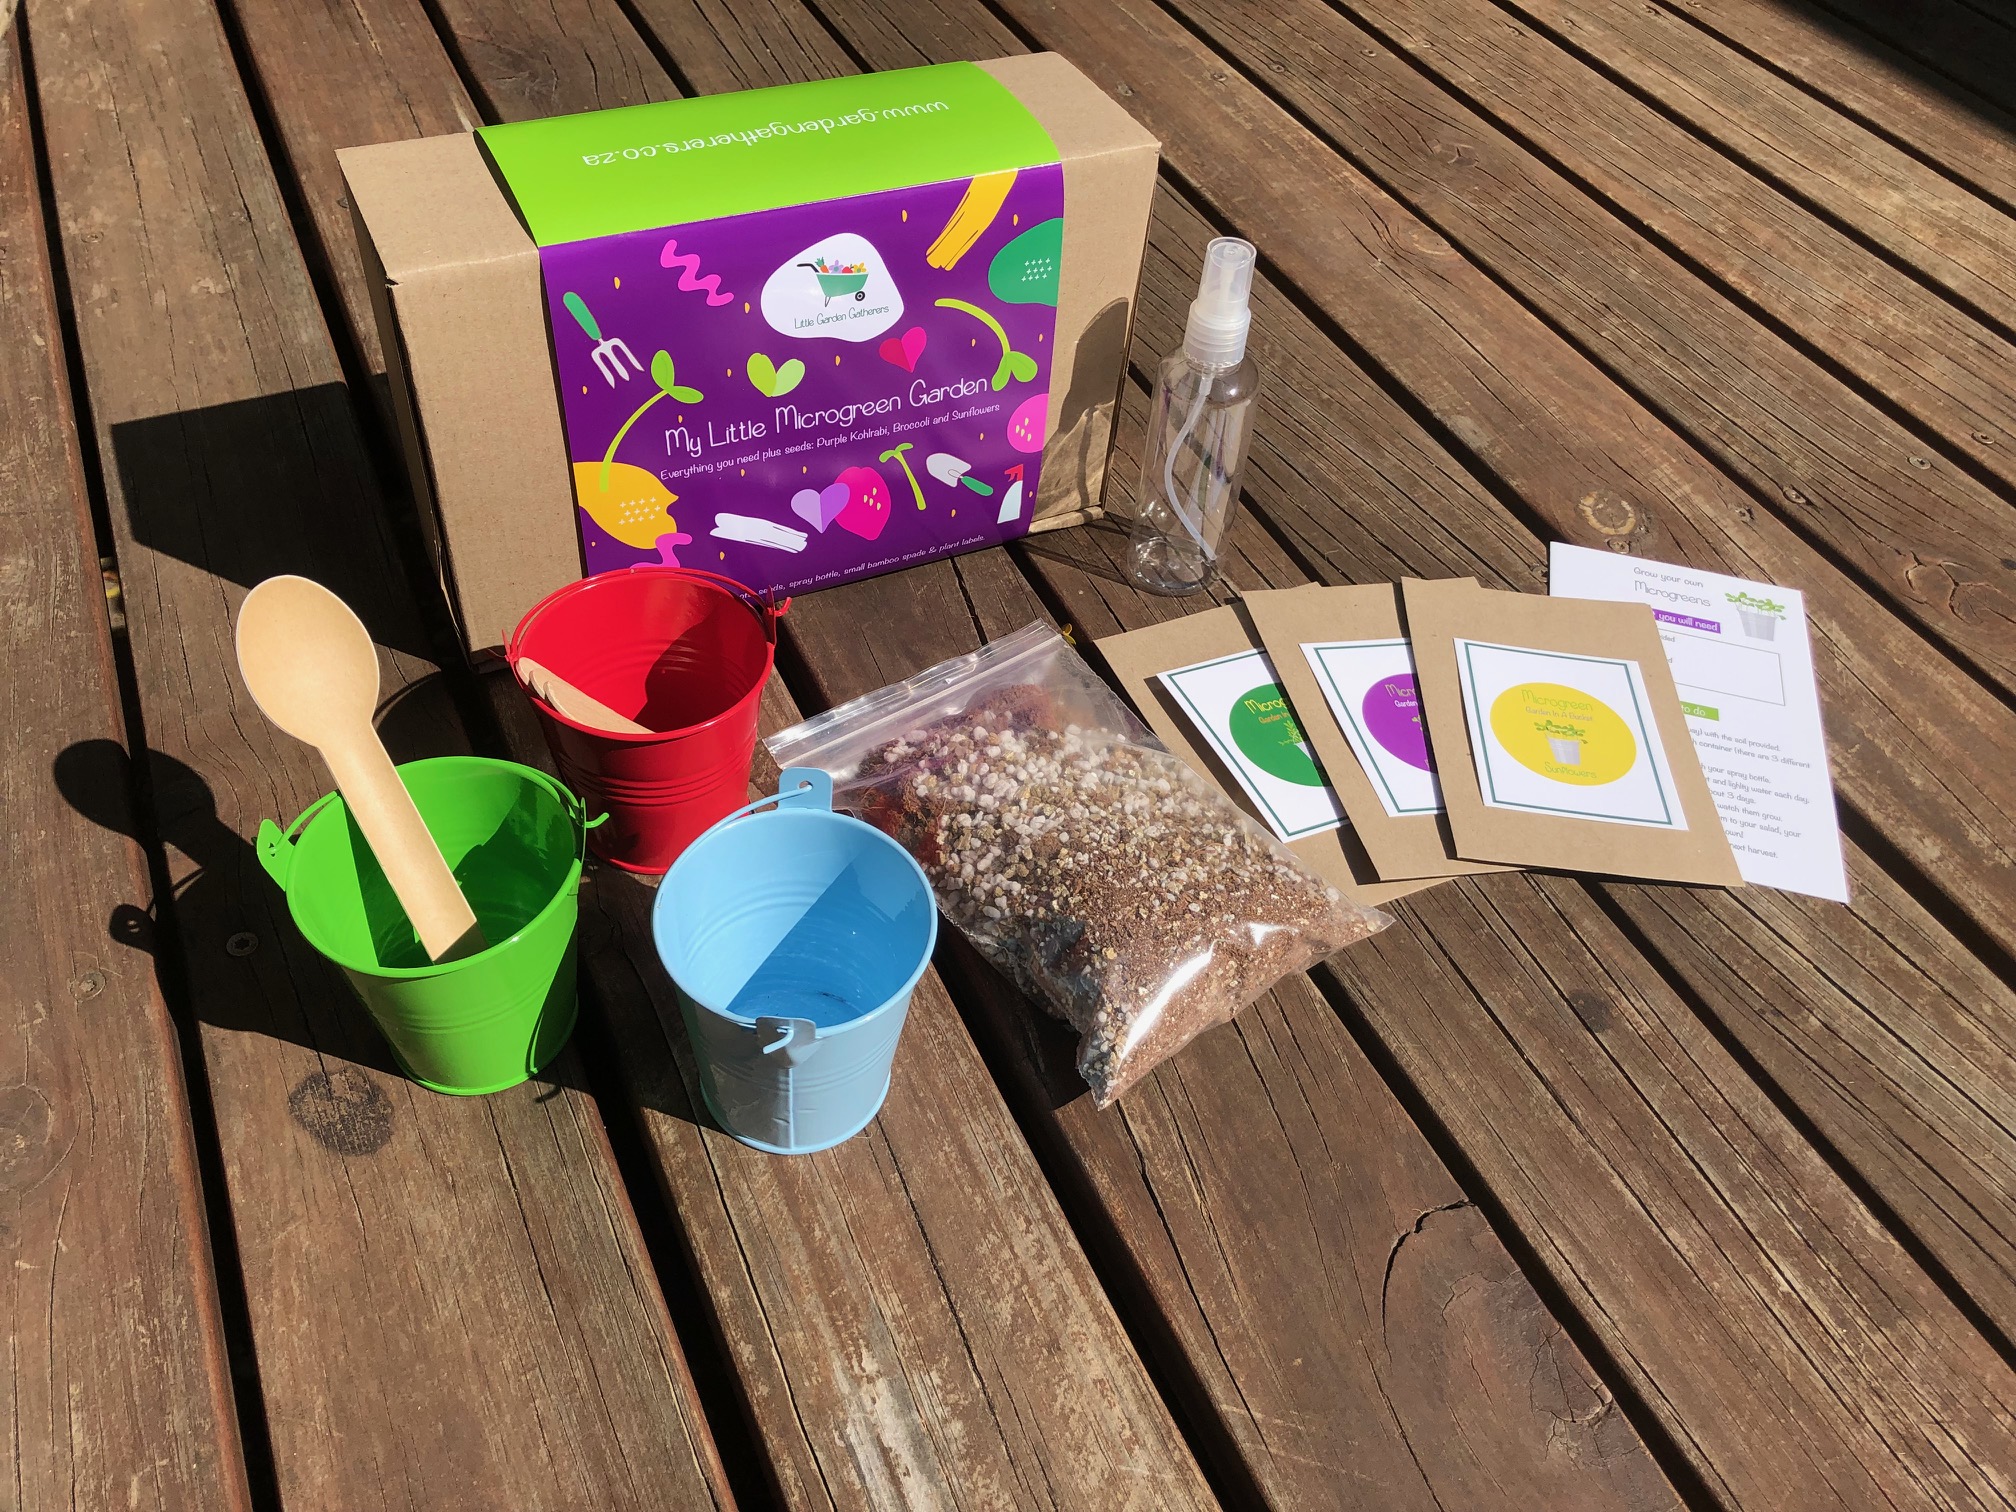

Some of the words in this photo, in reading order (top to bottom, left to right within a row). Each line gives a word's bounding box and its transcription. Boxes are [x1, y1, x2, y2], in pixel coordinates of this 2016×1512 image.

[581, 100, 950, 167] www.gardengatherers.co.za
[794, 318, 815, 330] Little
[816, 312, 847, 326] Garden
[848, 305, 890, 320] Gatherers
[665, 426, 702, 458] My
[709, 420, 767, 448] Little
[775, 395, 902, 434] Microgreen
[909, 378, 988, 408] Garden
[660, 463, 715, 481] Everything
[716, 458, 735, 472] you
[736, 450, 760, 465] need
[762, 447, 782, 463] plus
[784, 441, 815, 455] seeds:
[816, 433, 848, 451] Purple
[850, 426, 891, 442] Kohlrabi,
[893, 416, 931, 433] Broccoli
[932, 411, 950, 426] and
[951, 403, 1001, 421] Sunflowers
[758, 583, 786, 596] seds,
[789, 577, 813, 590] spray
[815, 570, 842, 583] bottle,
[843, 563, 866, 575] small
[867, 556, 900, 571] bamboo
[901, 549, 927, 563] spade
[928, 546, 938, 554] &
[938, 541, 960, 554] plant
[1633, 566, 1659, 581] Grow
[1660, 574, 1682, 585] your
[1684, 580, 1705, 588] own
[1634, 580, 1711, 608] Microgreens
[1658, 613, 1676, 623] you
[1677, 616, 1693, 627] will
[1695, 620, 1718, 631] need
[1521, 689, 1594, 712] Microgreen
[1693, 706, 1705, 716] do
[1525, 706, 1551, 717] Garden
[1552, 710, 1560, 718] In
[1703, 730, 1719, 740] with
[1721, 733, 1733, 742] the
[1734, 736, 1747, 745] soil
[1748, 739, 1781, 752] provided.
[1698, 740, 1733, 753] container
[1757, 752, 1770, 760] are
[1771, 754, 1779, 762] 3
[1780, 756, 1811, 769] different
[1544, 761, 1597, 779] Sunflowers
[1707, 764, 1725, 775] your
[1726, 768, 1748, 780] spray
[1712, 777, 1727, 787] and
[1750, 785, 1772, 796] water
[1773, 790, 1793, 800] each
[1726, 791, 1735, 800] 3
[1716, 802, 1740, 813] watch
[1741, 806, 1760, 817] them
[1730, 816, 1738, 825] to
[1739, 819, 1757, 830] your
[1783, 830, 1802, 839] your
[1747, 845, 1778, 859] harvest.
